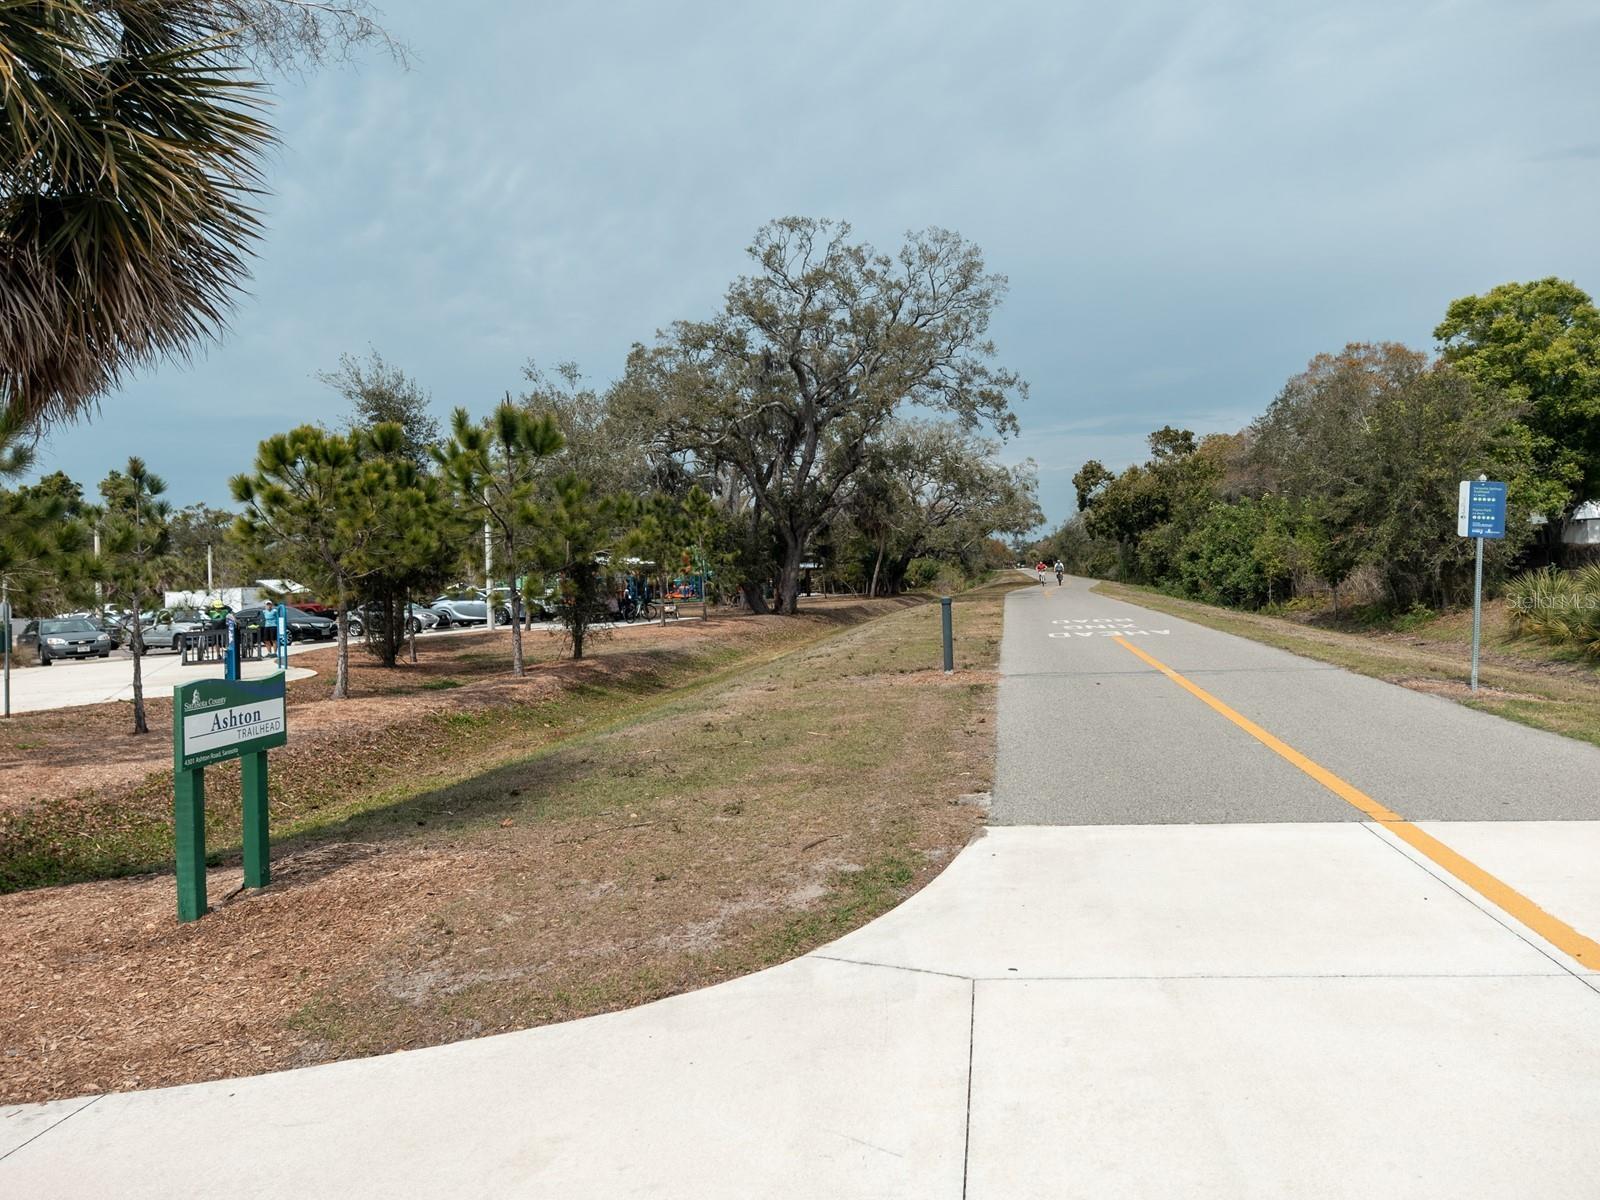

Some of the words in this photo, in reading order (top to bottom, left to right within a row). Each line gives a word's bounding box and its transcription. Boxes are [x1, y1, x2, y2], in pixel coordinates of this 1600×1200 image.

[1048, 629, 1171, 638] AHEAD
[208, 697, 226, 706] County
[211, 709, 261, 731] Ashton
[237, 721, 281, 739] TRAILHEAD
[196, 755, 210, 763] Ashton
